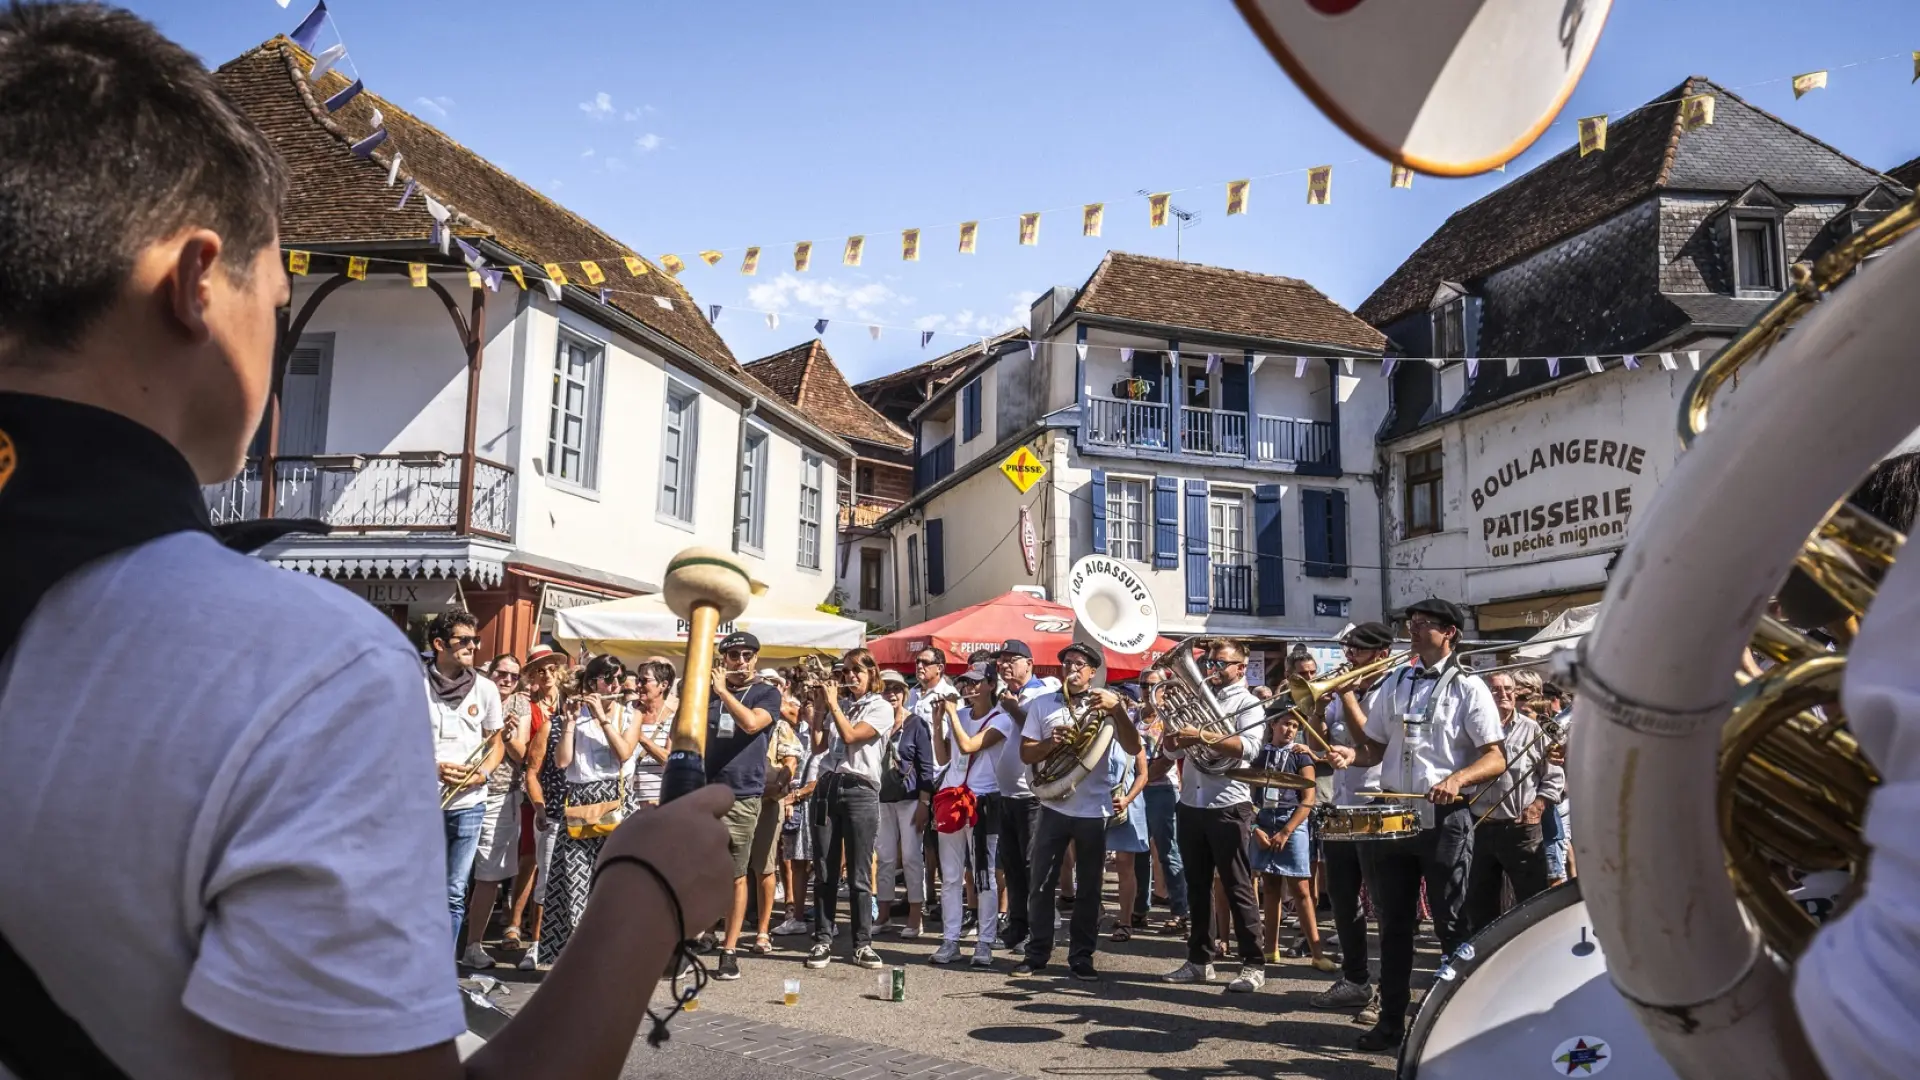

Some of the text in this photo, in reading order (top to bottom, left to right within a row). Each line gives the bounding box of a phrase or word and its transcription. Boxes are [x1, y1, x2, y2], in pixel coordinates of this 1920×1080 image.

[1006, 464, 1042, 474] PRESSE
[1471, 439, 1646, 512] BOULANGERIE
[1483, 487, 1631, 541] PATISSERIE
[1021, 508, 1036, 571] TABAC
[1491, 543, 1509, 558] au
[1513, 529, 1554, 557] péché
[1072, 560, 1146, 602] LOS AIGASSUTS
[961, 641, 1001, 653] PELFORTH
